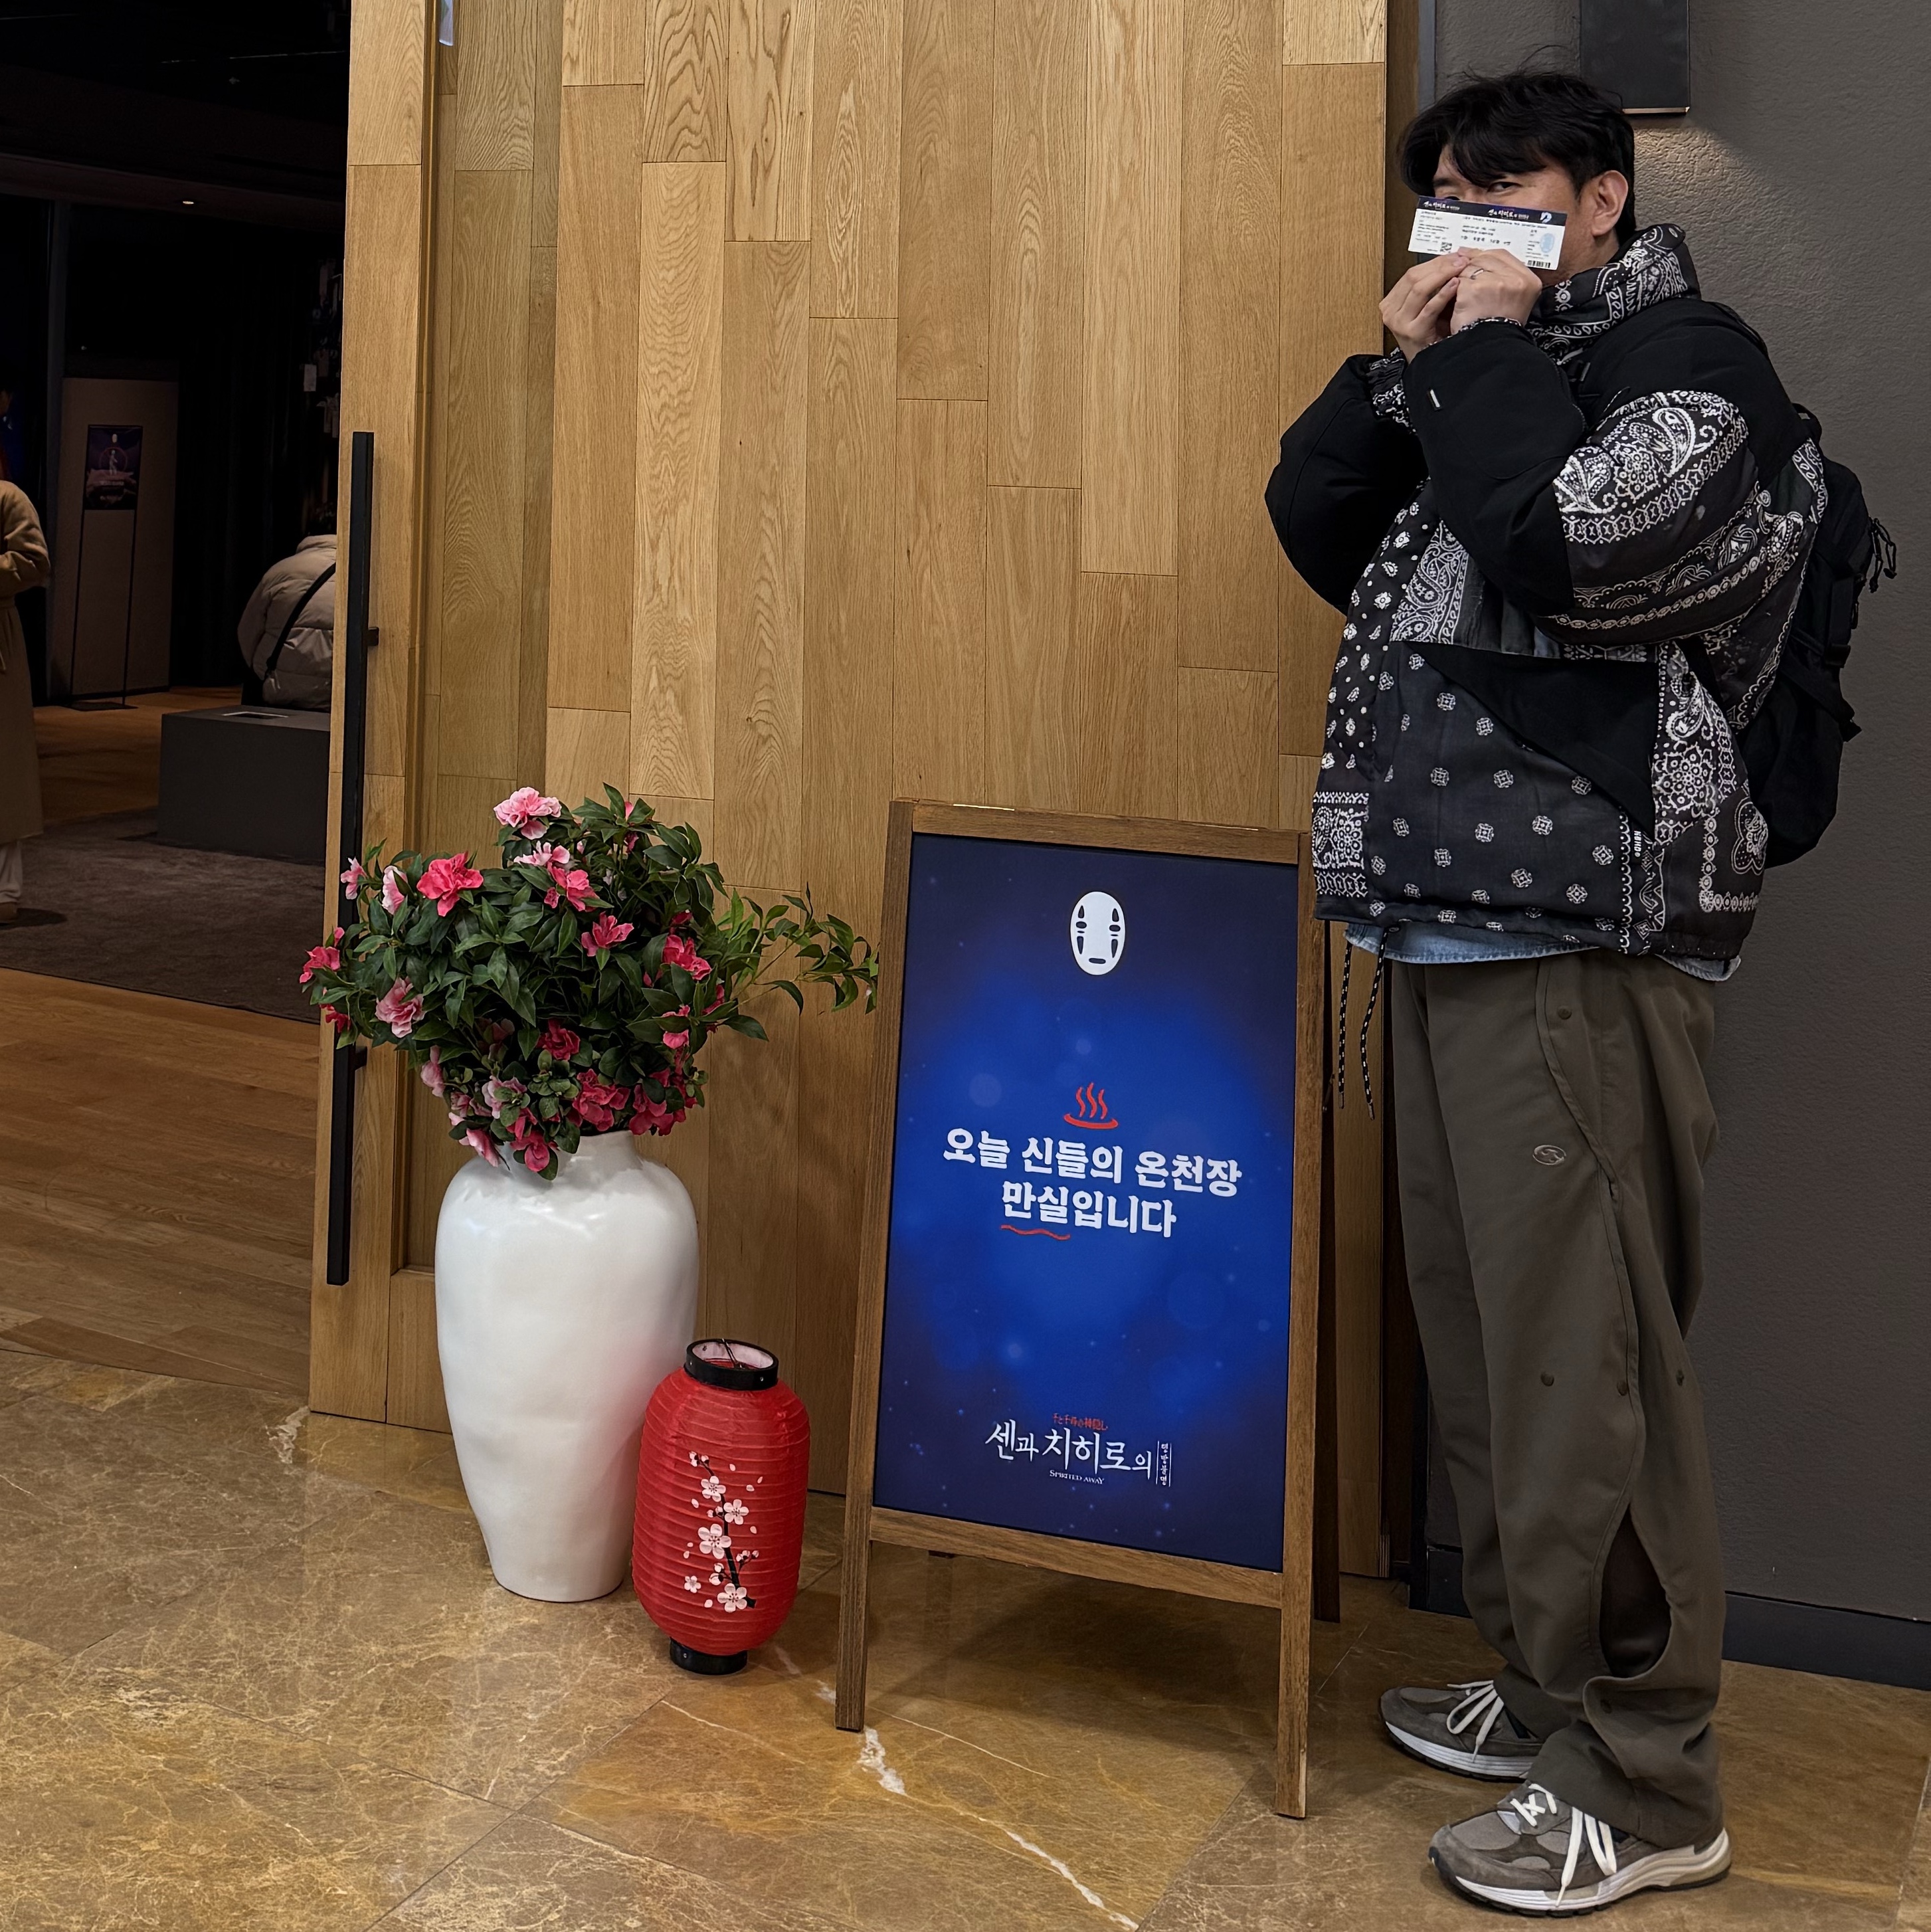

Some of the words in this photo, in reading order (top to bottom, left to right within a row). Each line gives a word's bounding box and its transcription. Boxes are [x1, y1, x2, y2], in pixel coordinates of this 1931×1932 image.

[943, 1127, 1010, 1169] 오늘
[1022, 1137, 1123, 1184] 신들의
[1135, 1151, 1243, 1197] 온천장
[1001, 1181, 1177, 1238] 만실입니다
[984, 1418, 1040, 1462] 센과
[1042, 1427, 1152, 1480] 치히로의
